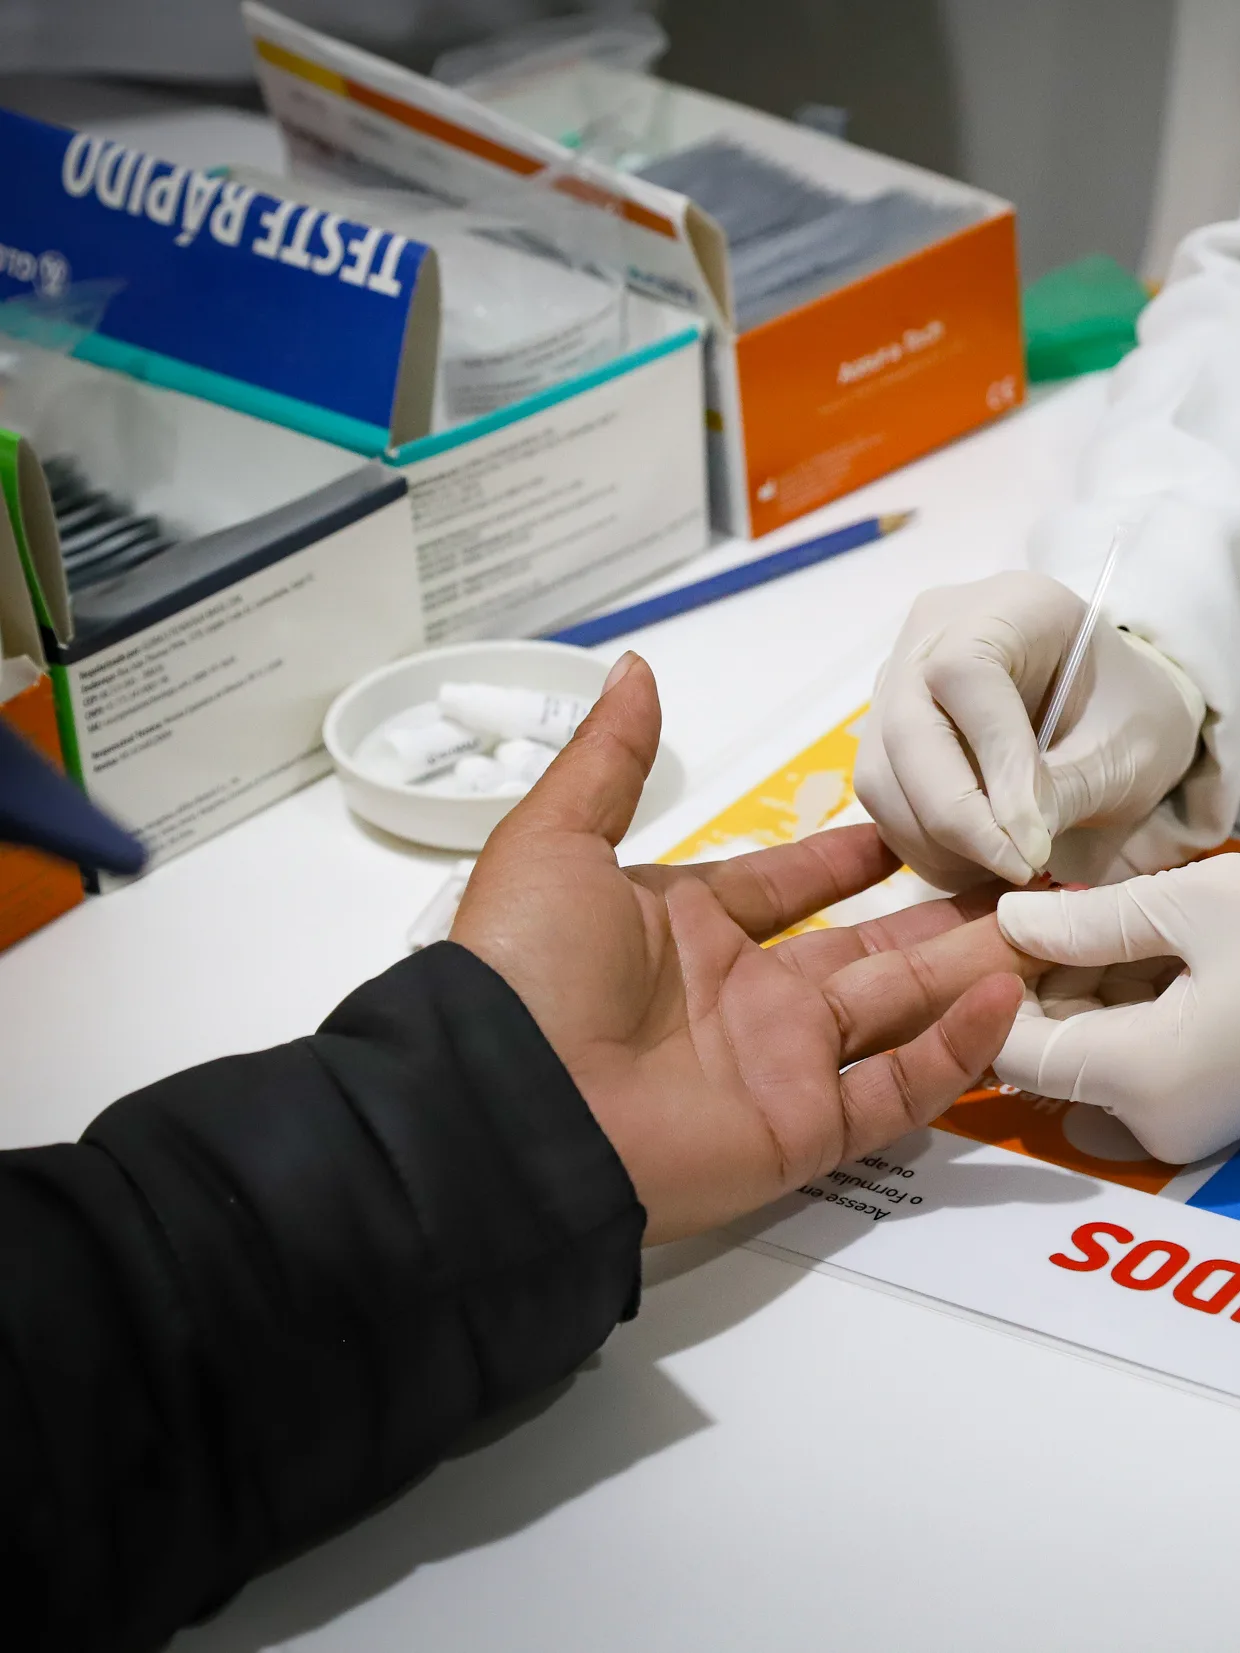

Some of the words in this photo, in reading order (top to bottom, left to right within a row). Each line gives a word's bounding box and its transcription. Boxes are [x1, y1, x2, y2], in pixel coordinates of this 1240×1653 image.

[61, 131, 261, 248] RÁPIDO
[252, 199, 408, 298] TESTE
[854, 1155, 890, 1172] apr
[888, 1165, 915, 1179] ou
[824, 1168, 909, 1205] Formulár
[908, 1195, 924, 1206] o
[824, 1192, 892, 1222] Acesse
